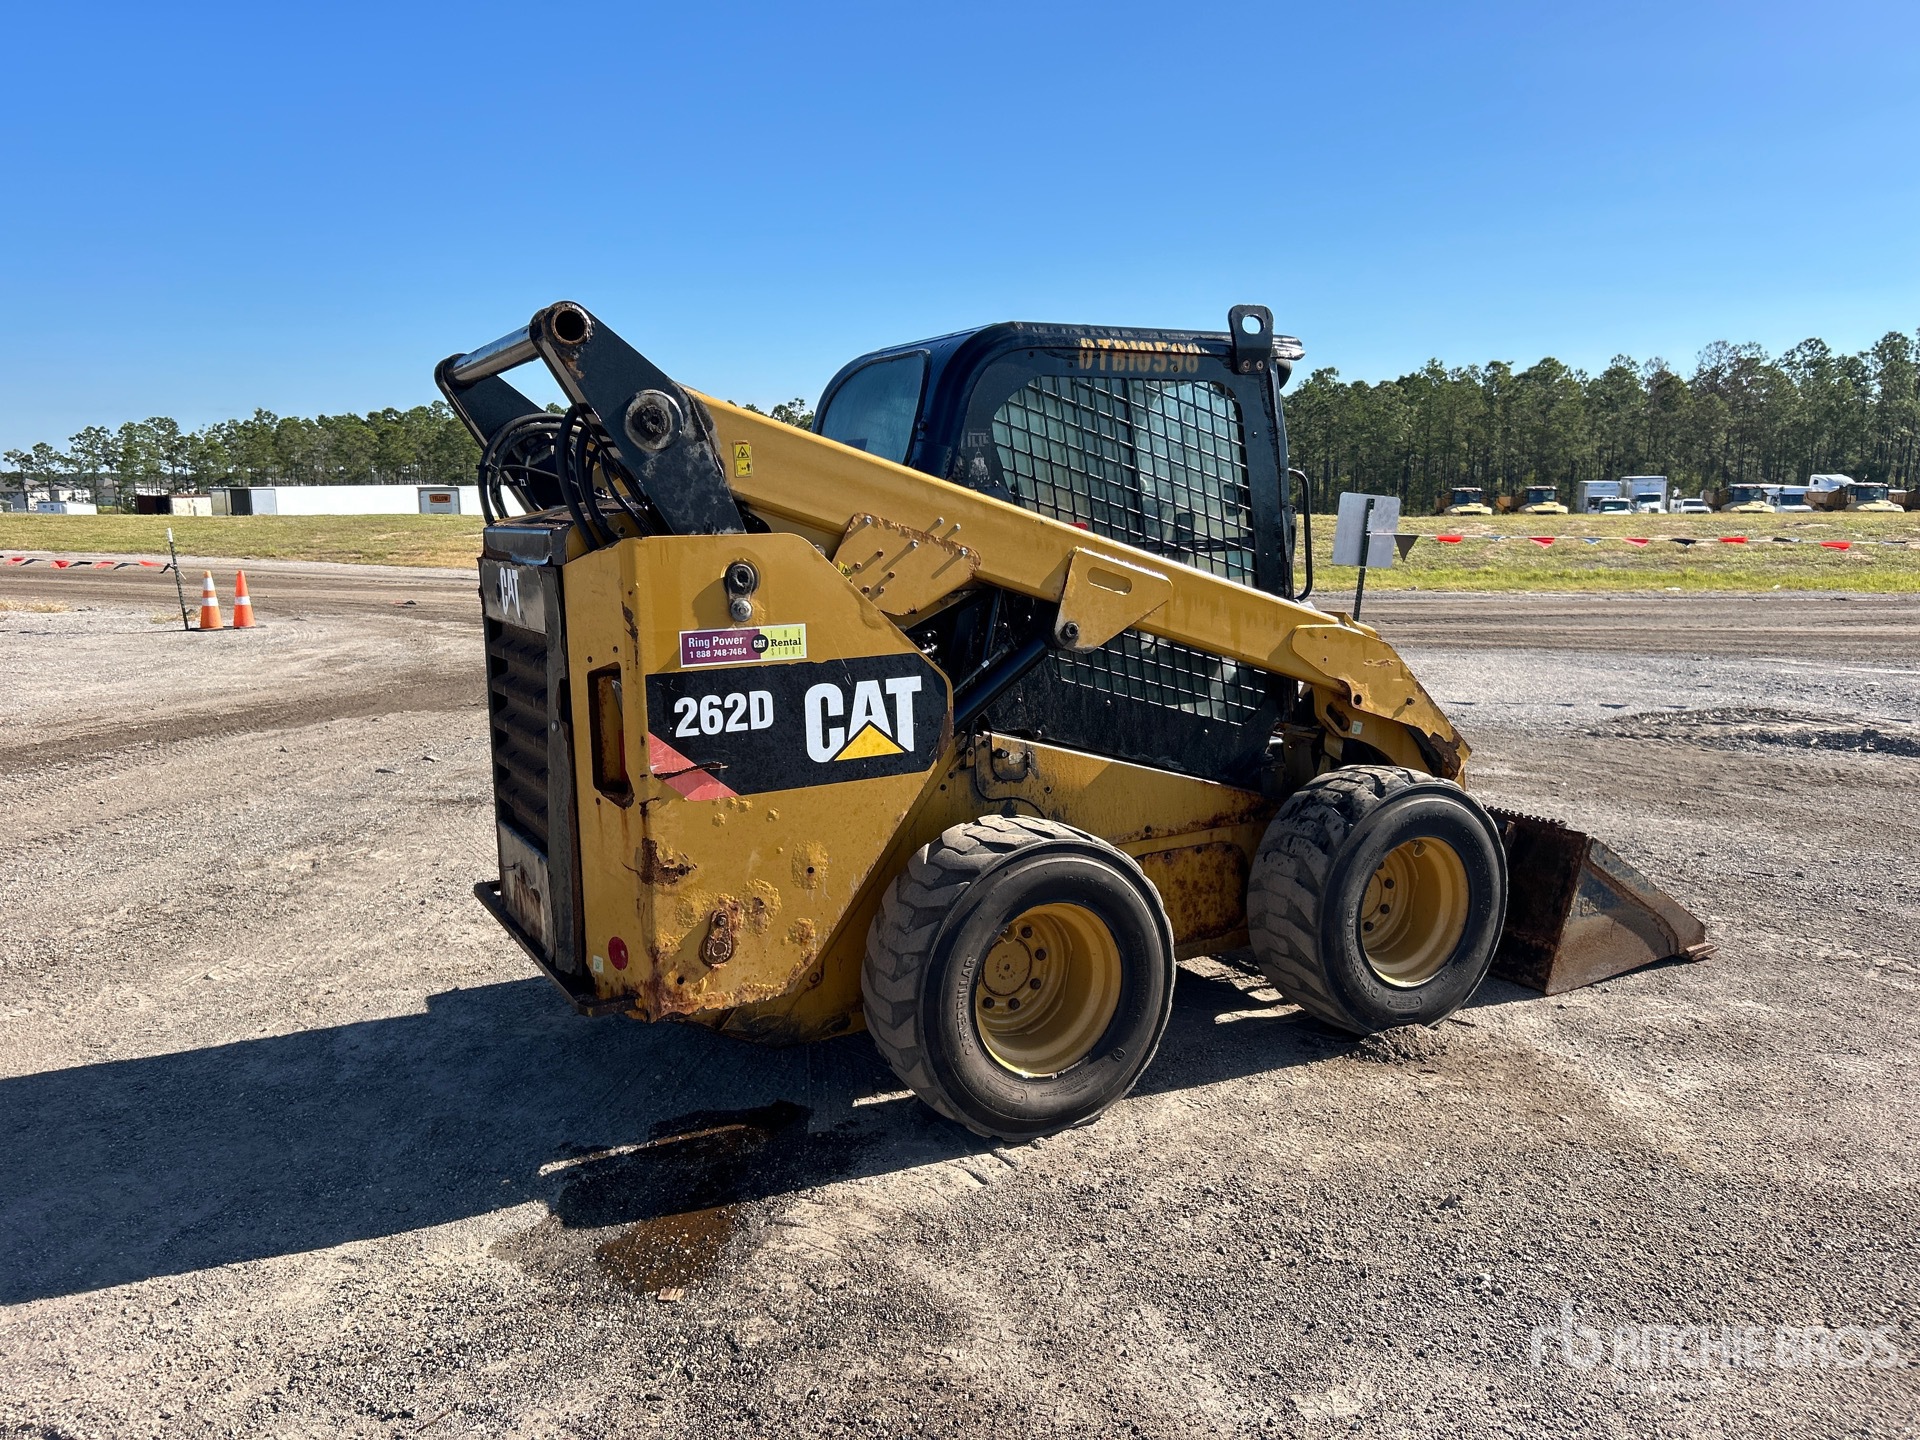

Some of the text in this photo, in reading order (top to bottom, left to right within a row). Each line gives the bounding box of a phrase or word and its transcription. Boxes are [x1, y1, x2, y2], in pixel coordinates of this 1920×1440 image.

[500, 567, 520, 618] CAT
[688, 636, 744, 649] Ring Power
[753, 639, 765, 648] CAT
[770, 638, 801, 647] Rental
[696, 650, 711, 658] 888
[674, 690, 774, 738] 262D
[804, 676, 922, 763] CAT
